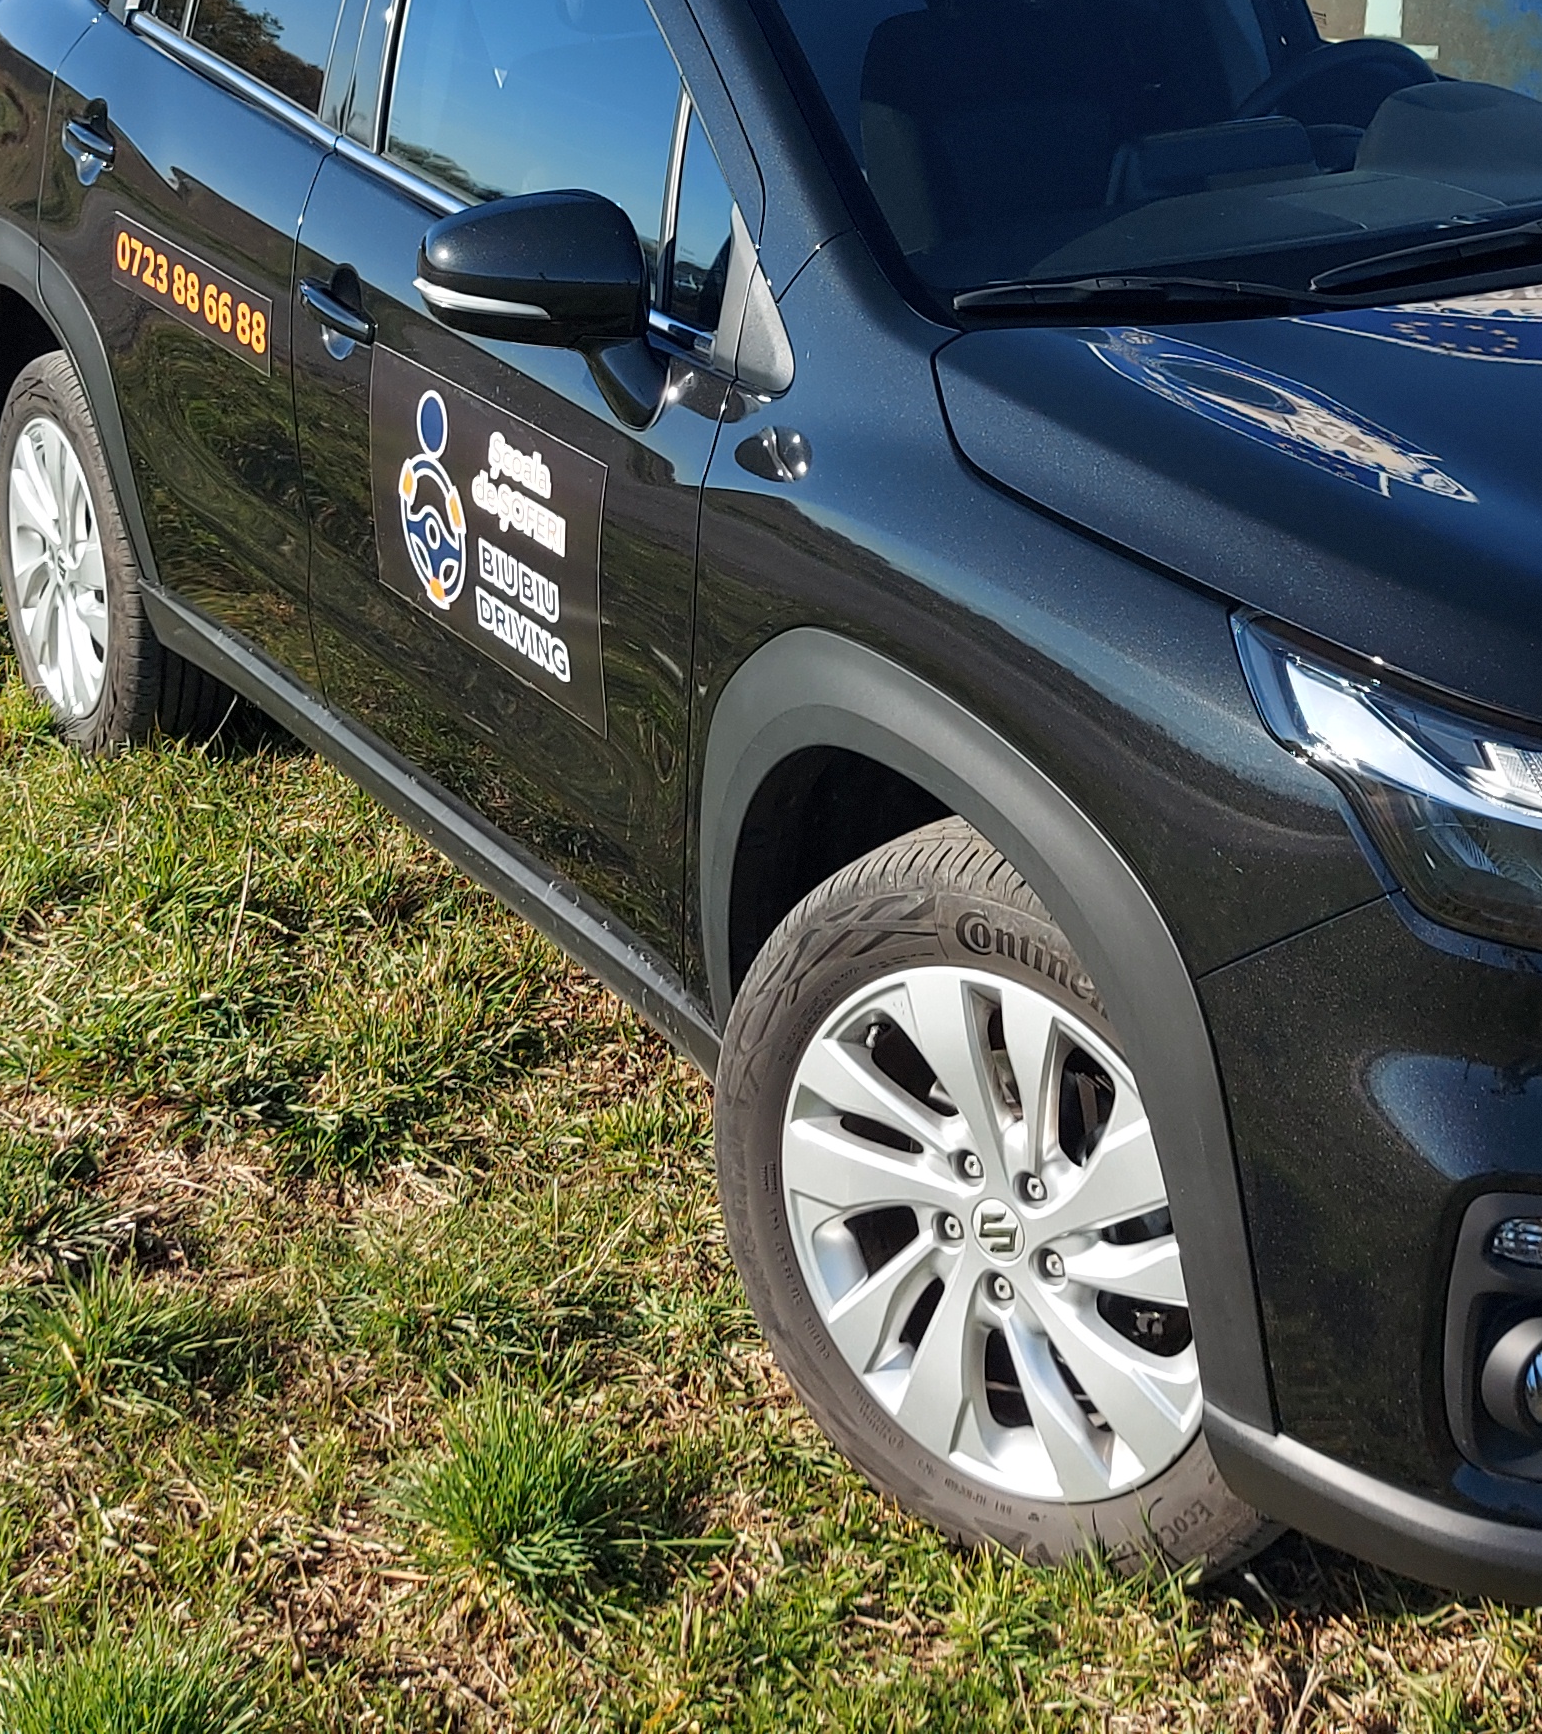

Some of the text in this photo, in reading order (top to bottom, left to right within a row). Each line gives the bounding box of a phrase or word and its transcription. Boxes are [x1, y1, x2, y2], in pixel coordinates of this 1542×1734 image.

[116, 231, 267, 355] 0723 88 66 88
[475, 585, 571, 683] DRIVING
